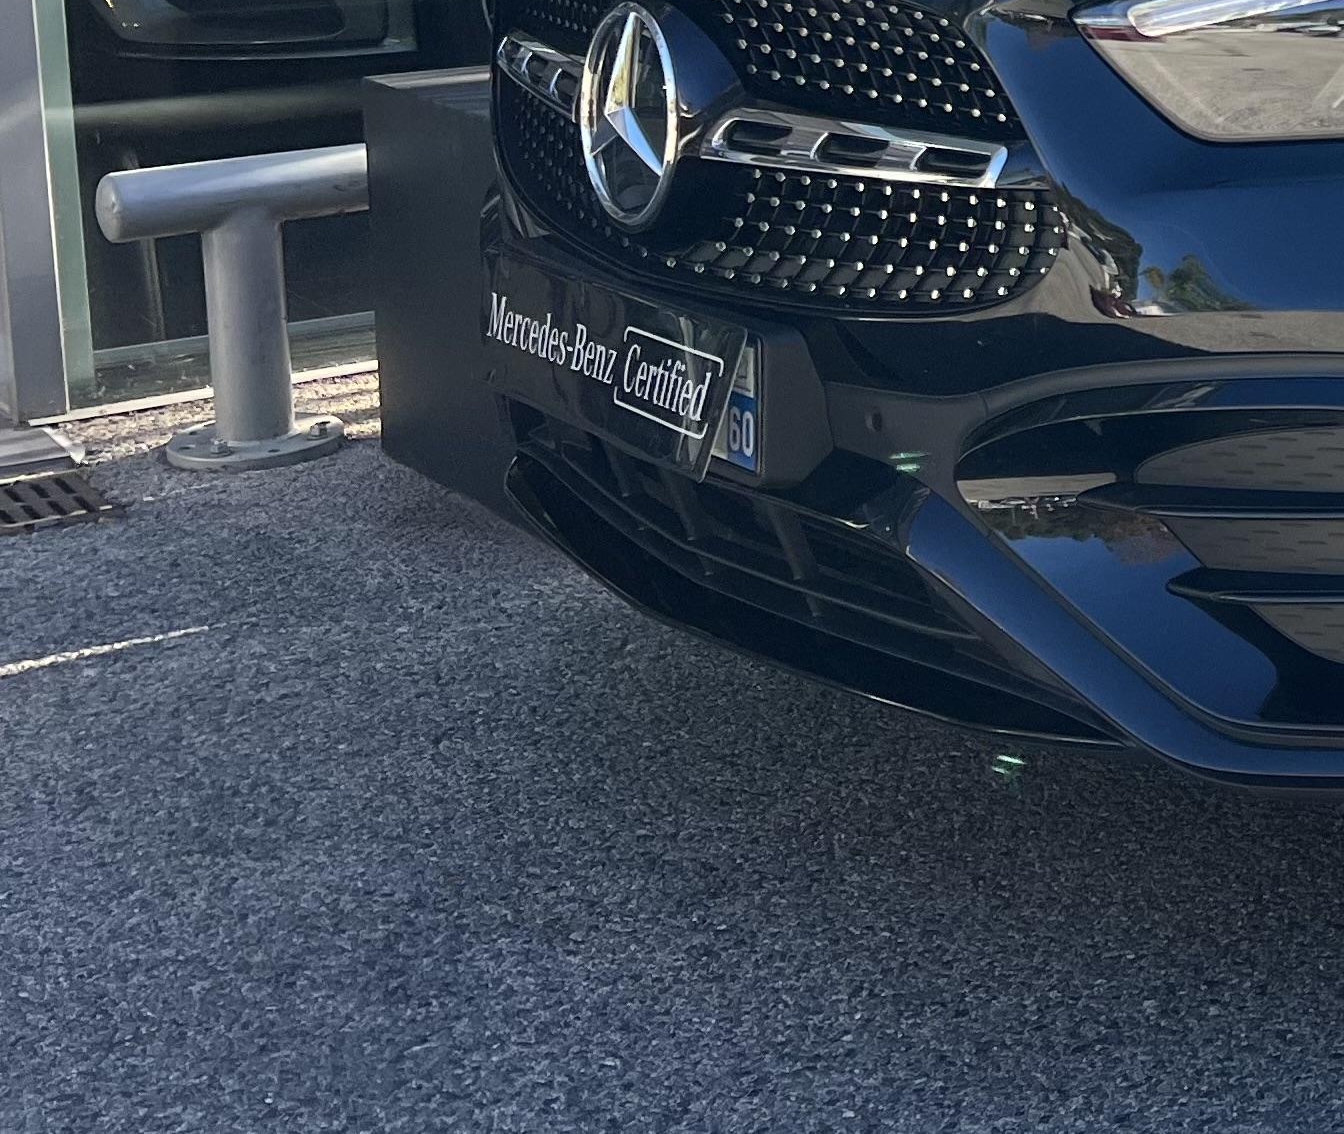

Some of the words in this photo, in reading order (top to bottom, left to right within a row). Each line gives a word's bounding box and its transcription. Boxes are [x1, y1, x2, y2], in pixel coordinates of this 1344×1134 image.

[485, 291, 618, 385] Mercedes-Benz
[622, 343, 711, 422] Certified
[728, 410, 755, 458] 60
